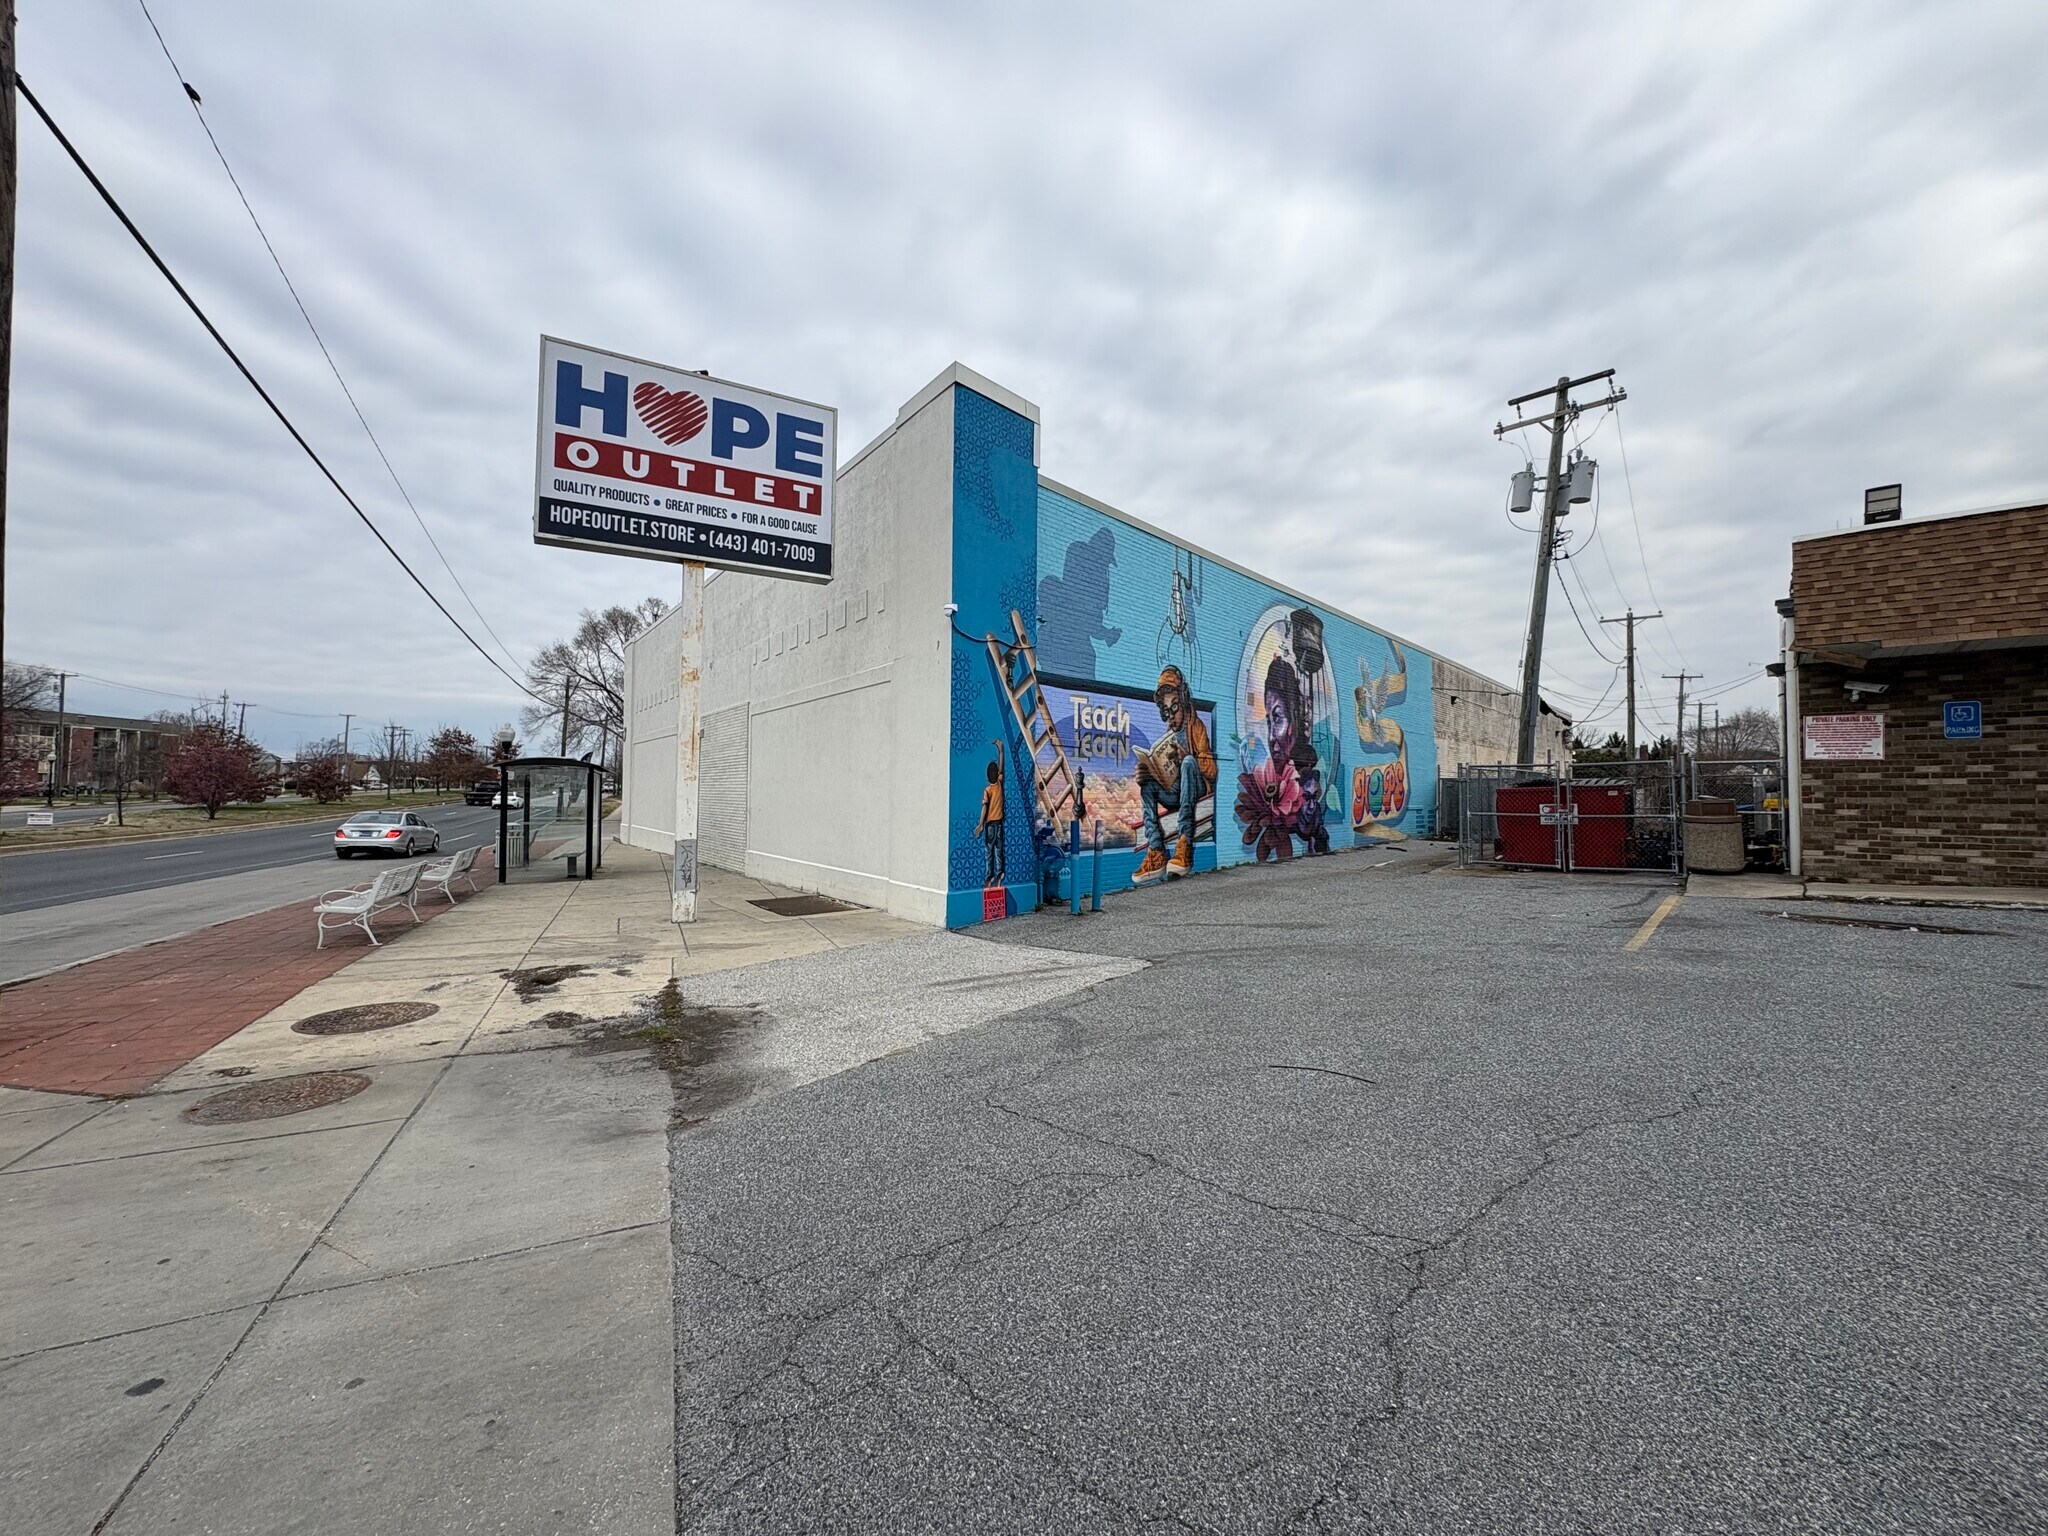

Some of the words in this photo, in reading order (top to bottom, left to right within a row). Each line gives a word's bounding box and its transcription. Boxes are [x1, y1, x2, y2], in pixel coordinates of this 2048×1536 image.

[566, 441, 815, 510] OUTLET
[549, 504, 696, 544] HOPEOUTLET.STORE
[709, 530, 748, 553] (443)
[751, 538, 816, 563] 401-7009
[553, 478, 597, 497] QUALITY
[599, 486, 651, 506] PRODUCTS
[665, 498, 695, 514] GREAT
[696, 504, 728, 520] PRICES
[741, 511, 759, 525] FOR
[760, 515, 767, 526] A
[767, 516, 790, 531] GOOD
[791, 521, 818, 535] CAUSE
[1069, 694, 1130, 736] Teach
[1946, 726, 1980, 734] PARKING
[1353, 761, 1405, 825] HOPE
